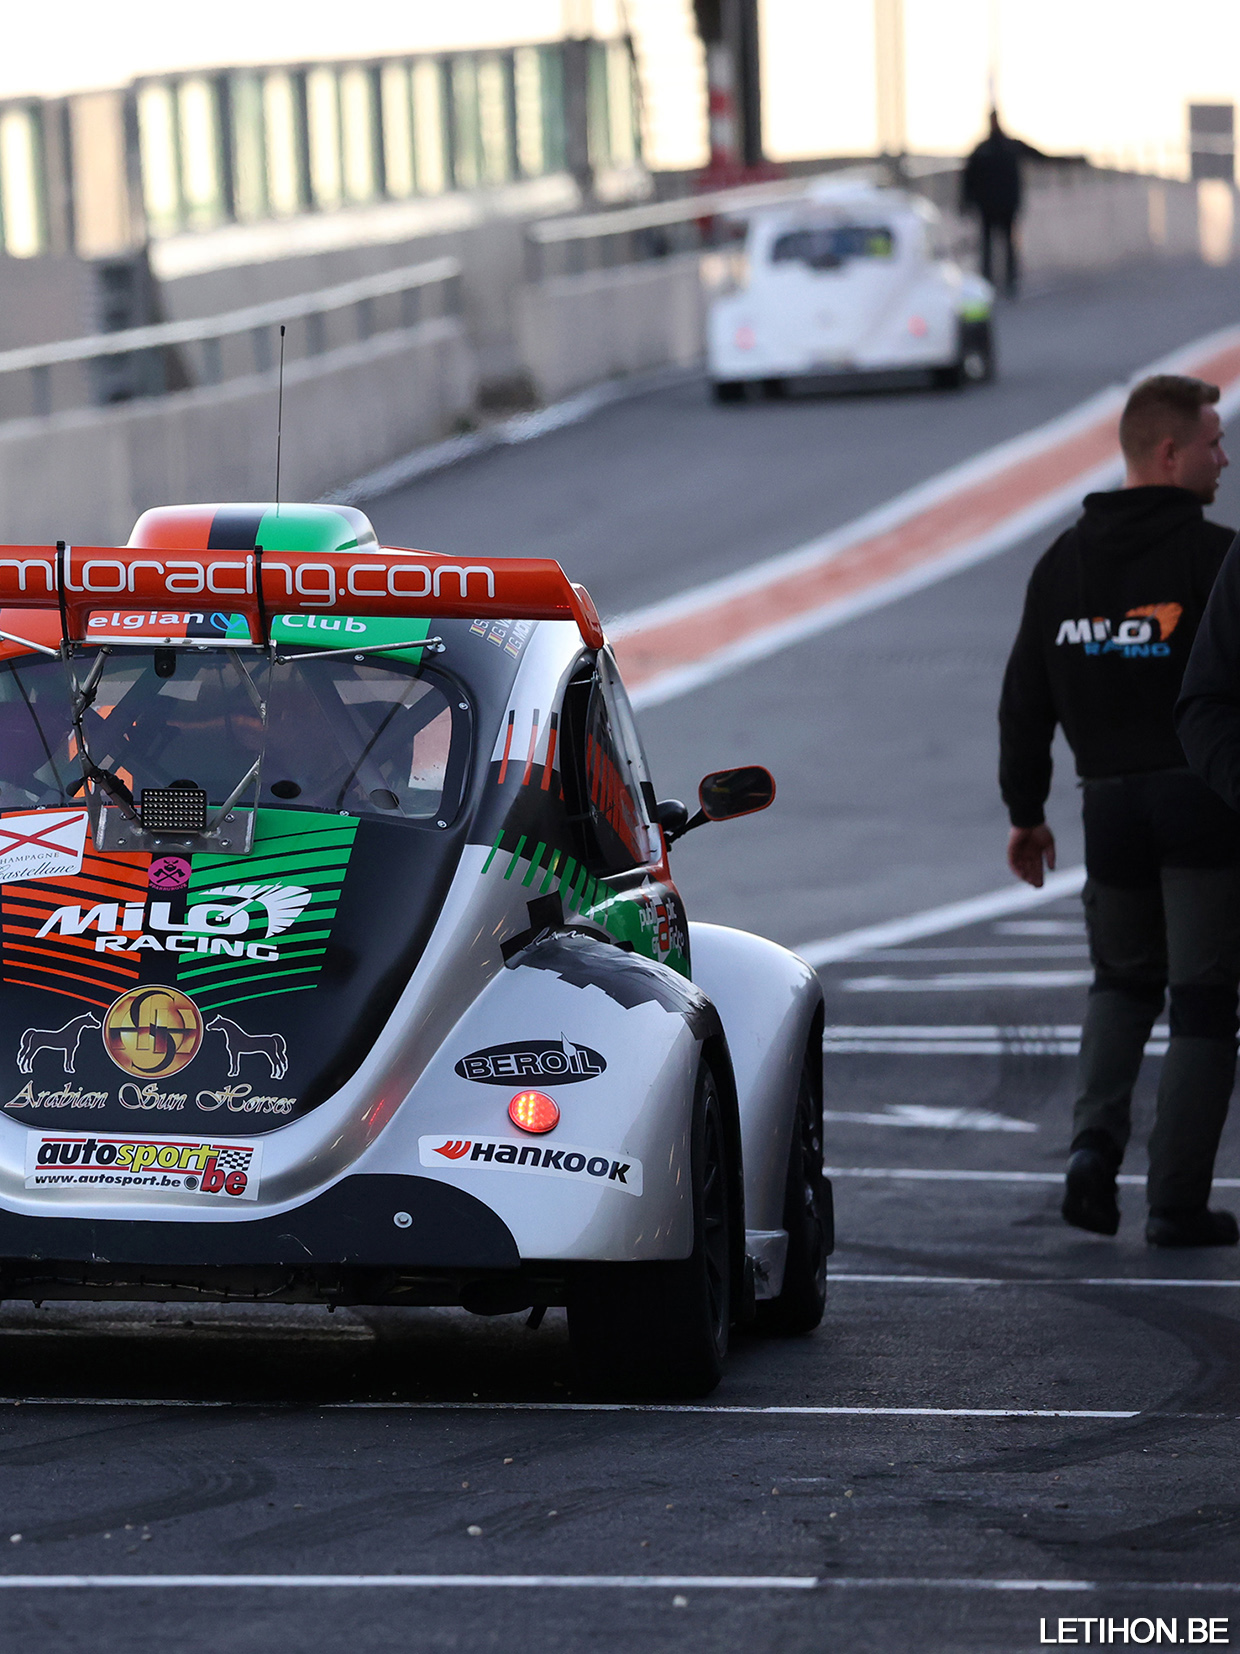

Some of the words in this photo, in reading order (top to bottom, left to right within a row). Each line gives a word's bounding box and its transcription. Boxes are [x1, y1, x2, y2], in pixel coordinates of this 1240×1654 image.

[88, 611, 204, 630] elgian
[281, 614, 368, 634] Club
[94, 935, 280, 962] RACING
[462, 1048, 602, 1080] BEROIL
[3, 1079, 109, 1110] Arabian
[118, 1082, 189, 1111] Sun
[195, 1083, 297, 1115] Horses
[34, 1174, 181, 1188] www.autosport.be
[36, 1138, 219, 1173] autosport
[200, 1157, 248, 1196] be
